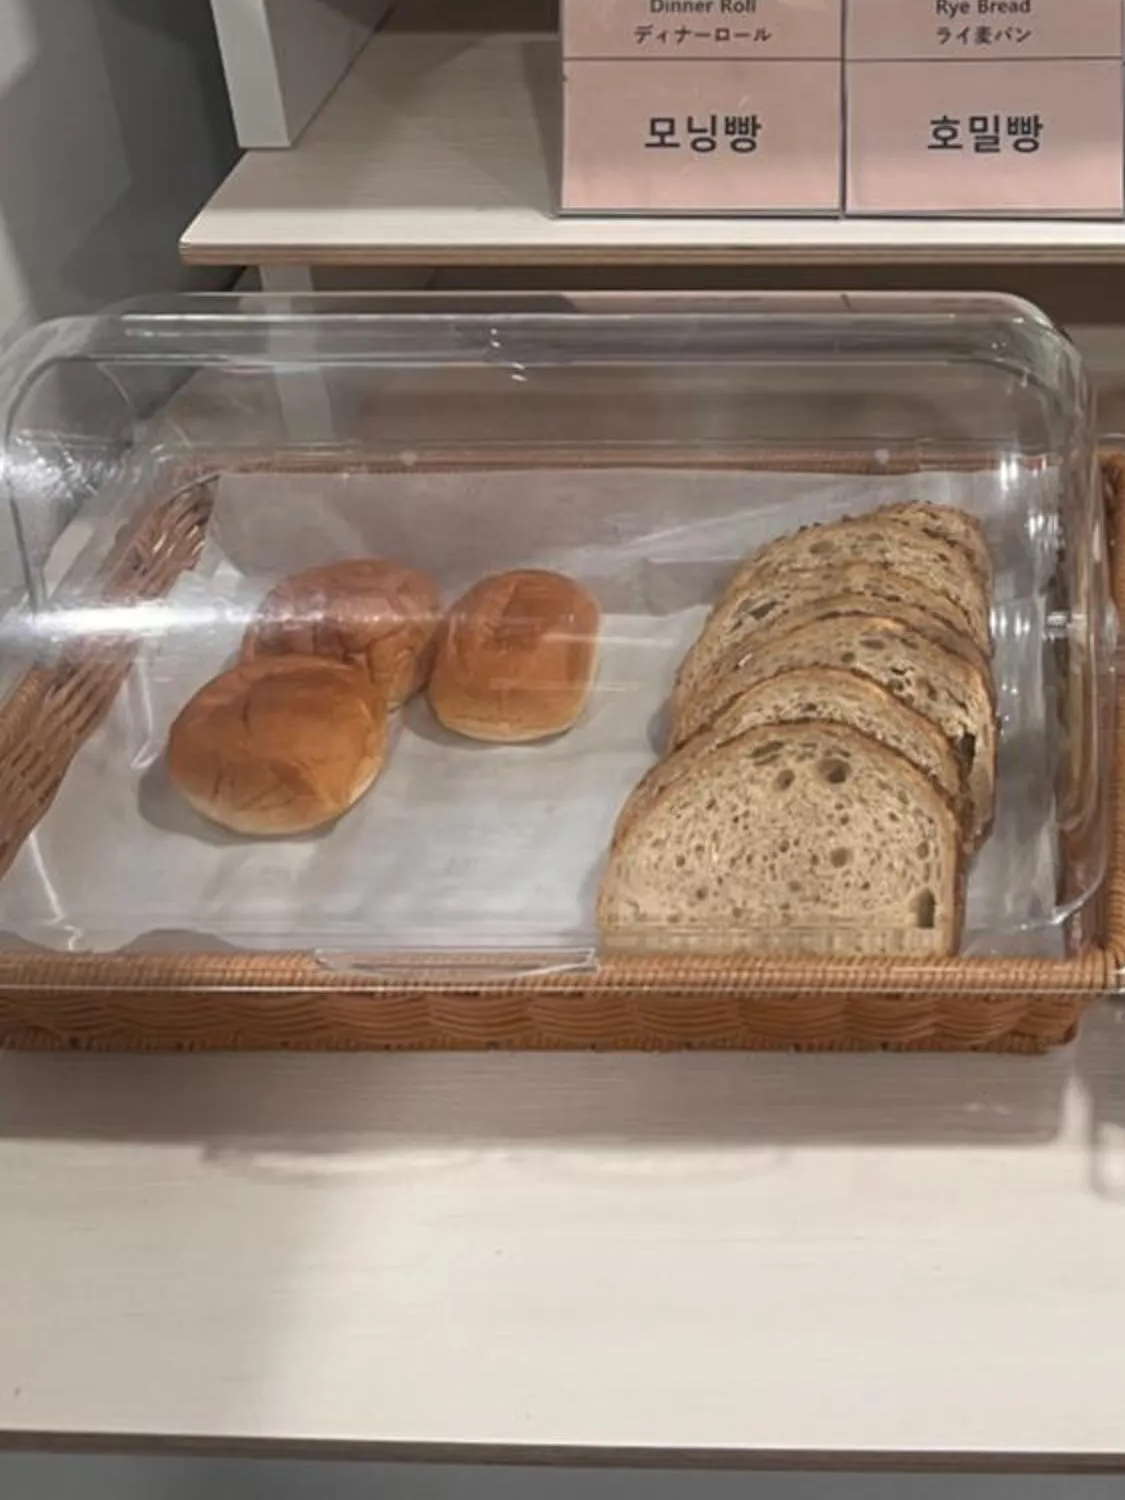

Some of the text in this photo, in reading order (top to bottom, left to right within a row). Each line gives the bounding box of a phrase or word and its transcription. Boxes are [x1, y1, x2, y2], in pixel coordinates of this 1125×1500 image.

[634, 25, 773, 45] ディナーロール
[644, 113, 762, 154] 모닝빵
[927, 113, 1043, 155] 호밀빵
